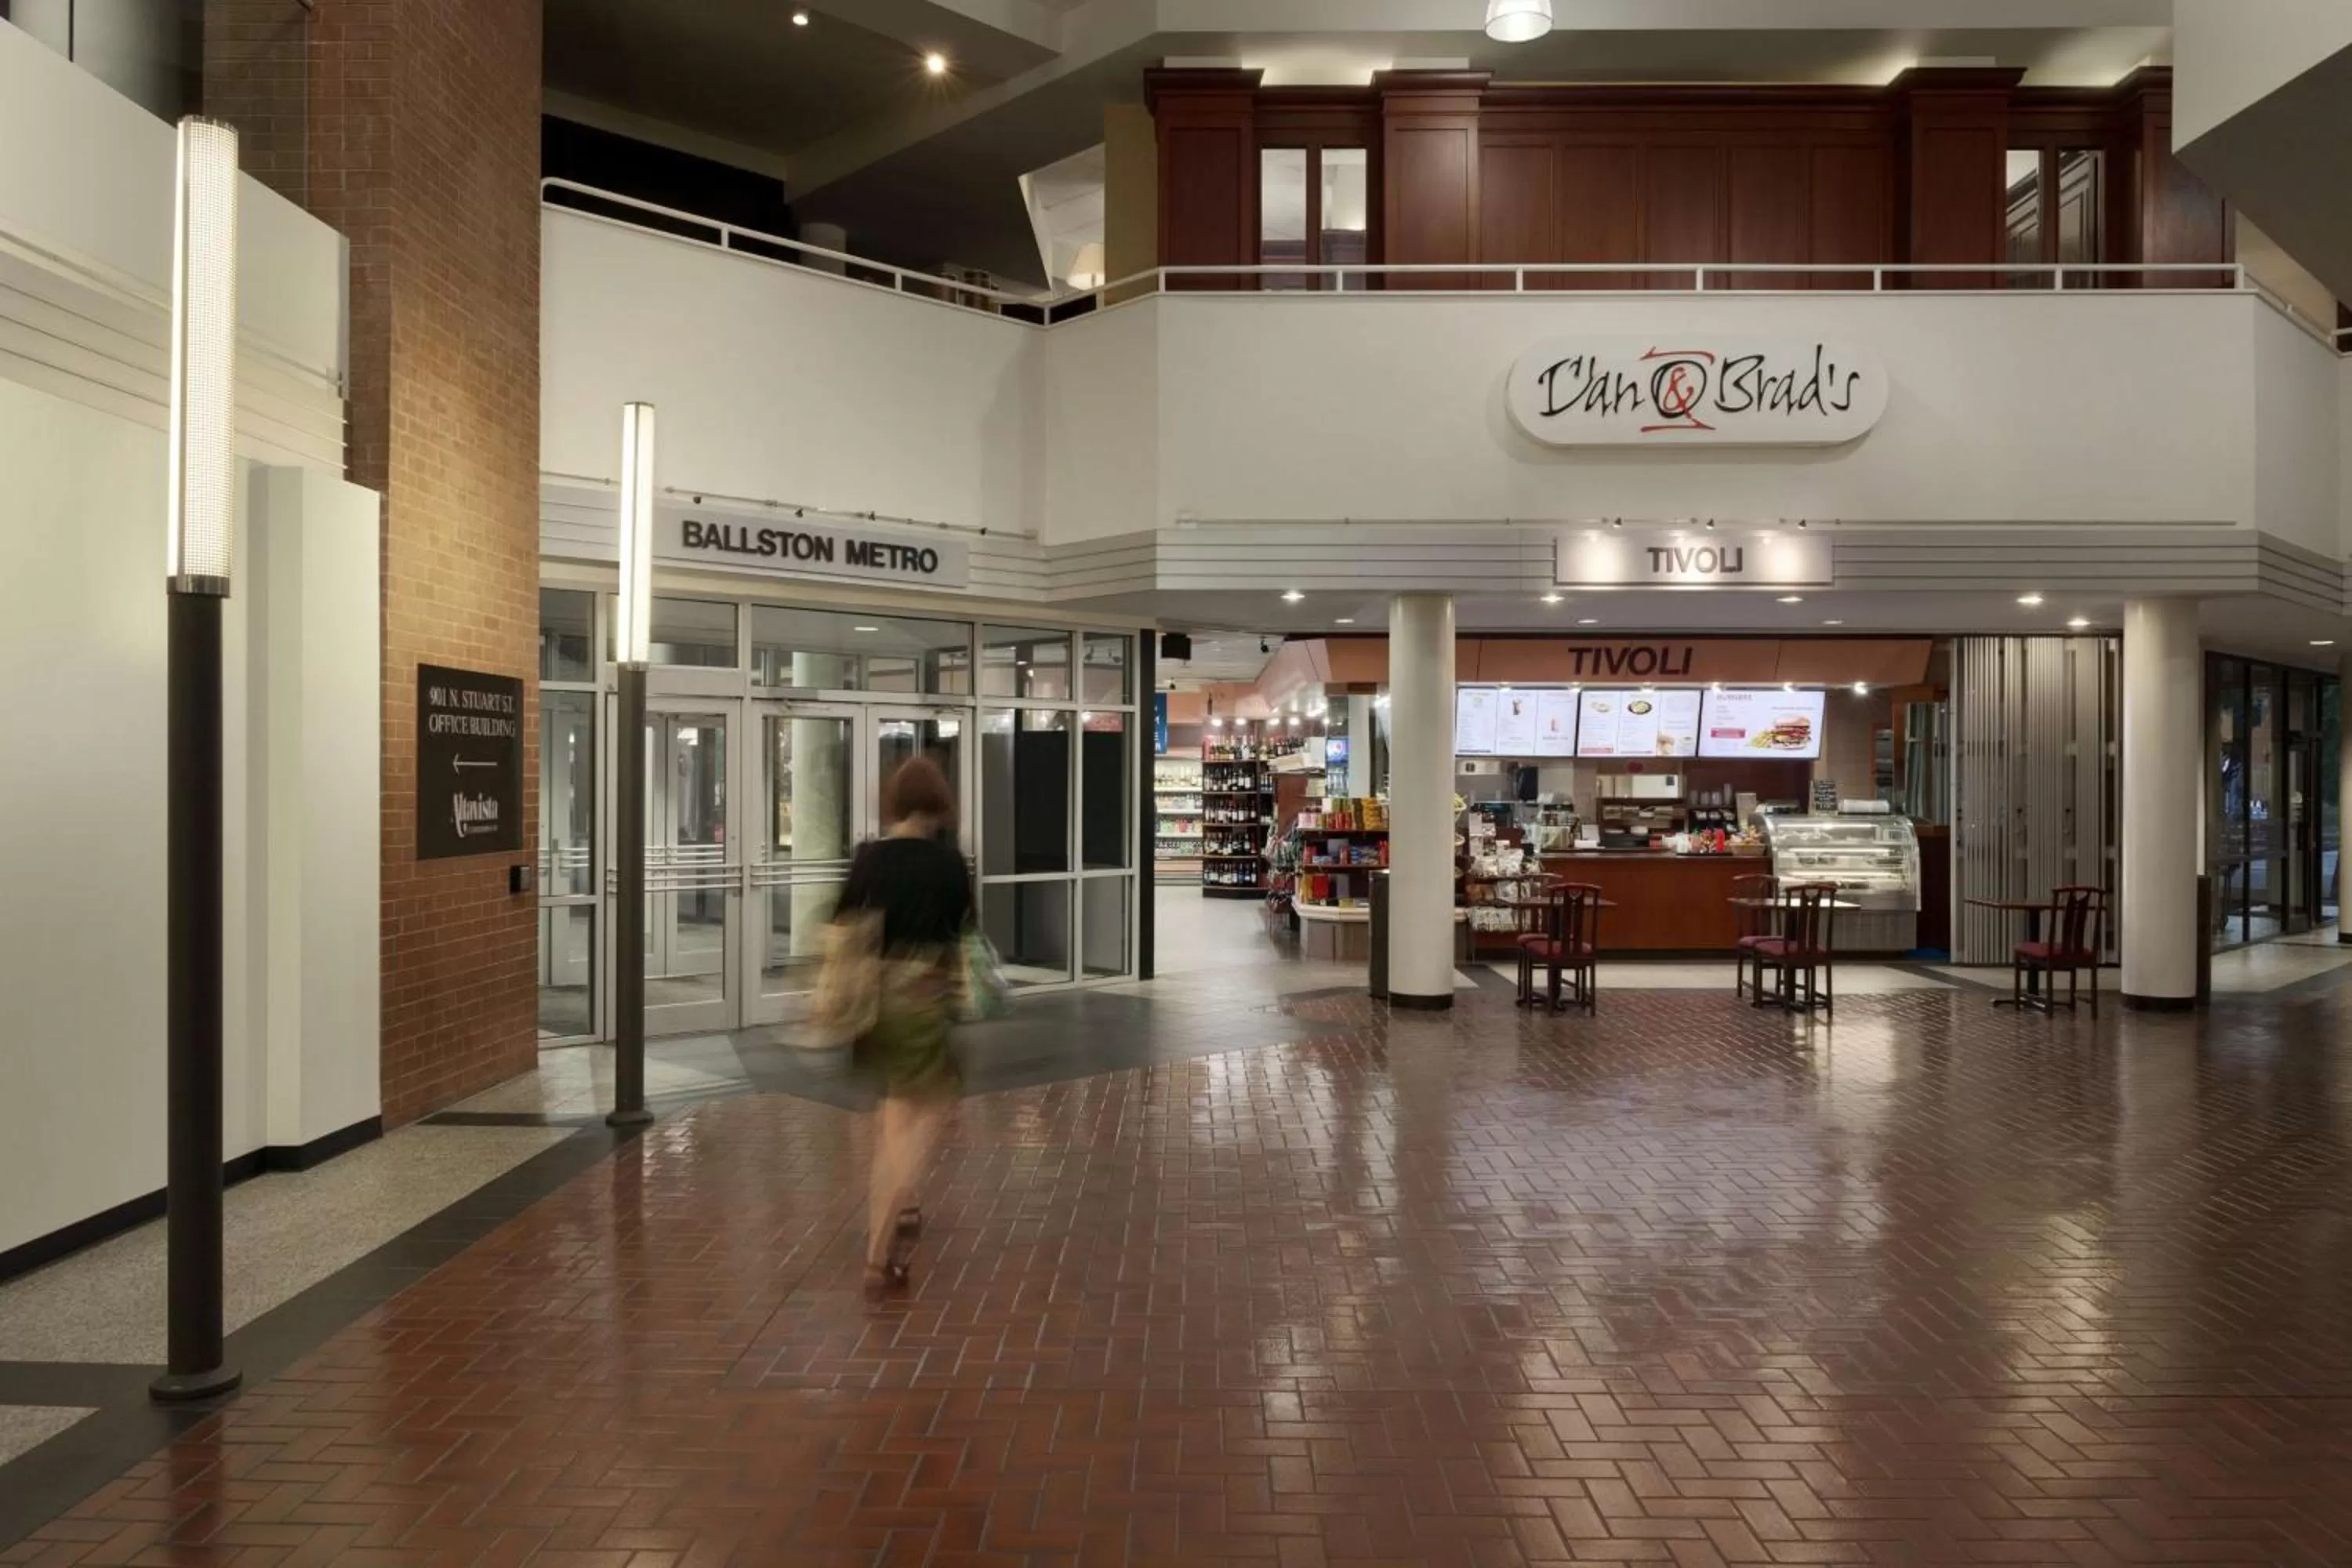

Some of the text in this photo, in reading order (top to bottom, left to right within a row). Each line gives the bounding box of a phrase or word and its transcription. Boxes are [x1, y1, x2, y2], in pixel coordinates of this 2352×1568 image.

[1661, 365, 1696, 419] &
[1713, 343, 1860, 416] Brad's
[681, 520, 938, 574] BALLSTON METRO
[1646, 546, 1744, 573] TIVOLI
[1567, 646, 1693, 676] TIVOLI
[429, 686, 446, 707] 901
[448, 688, 460, 708] N.
[462, 690, 501, 712] STUART
[429, 713, 515, 737] OFFICE BUILDING
